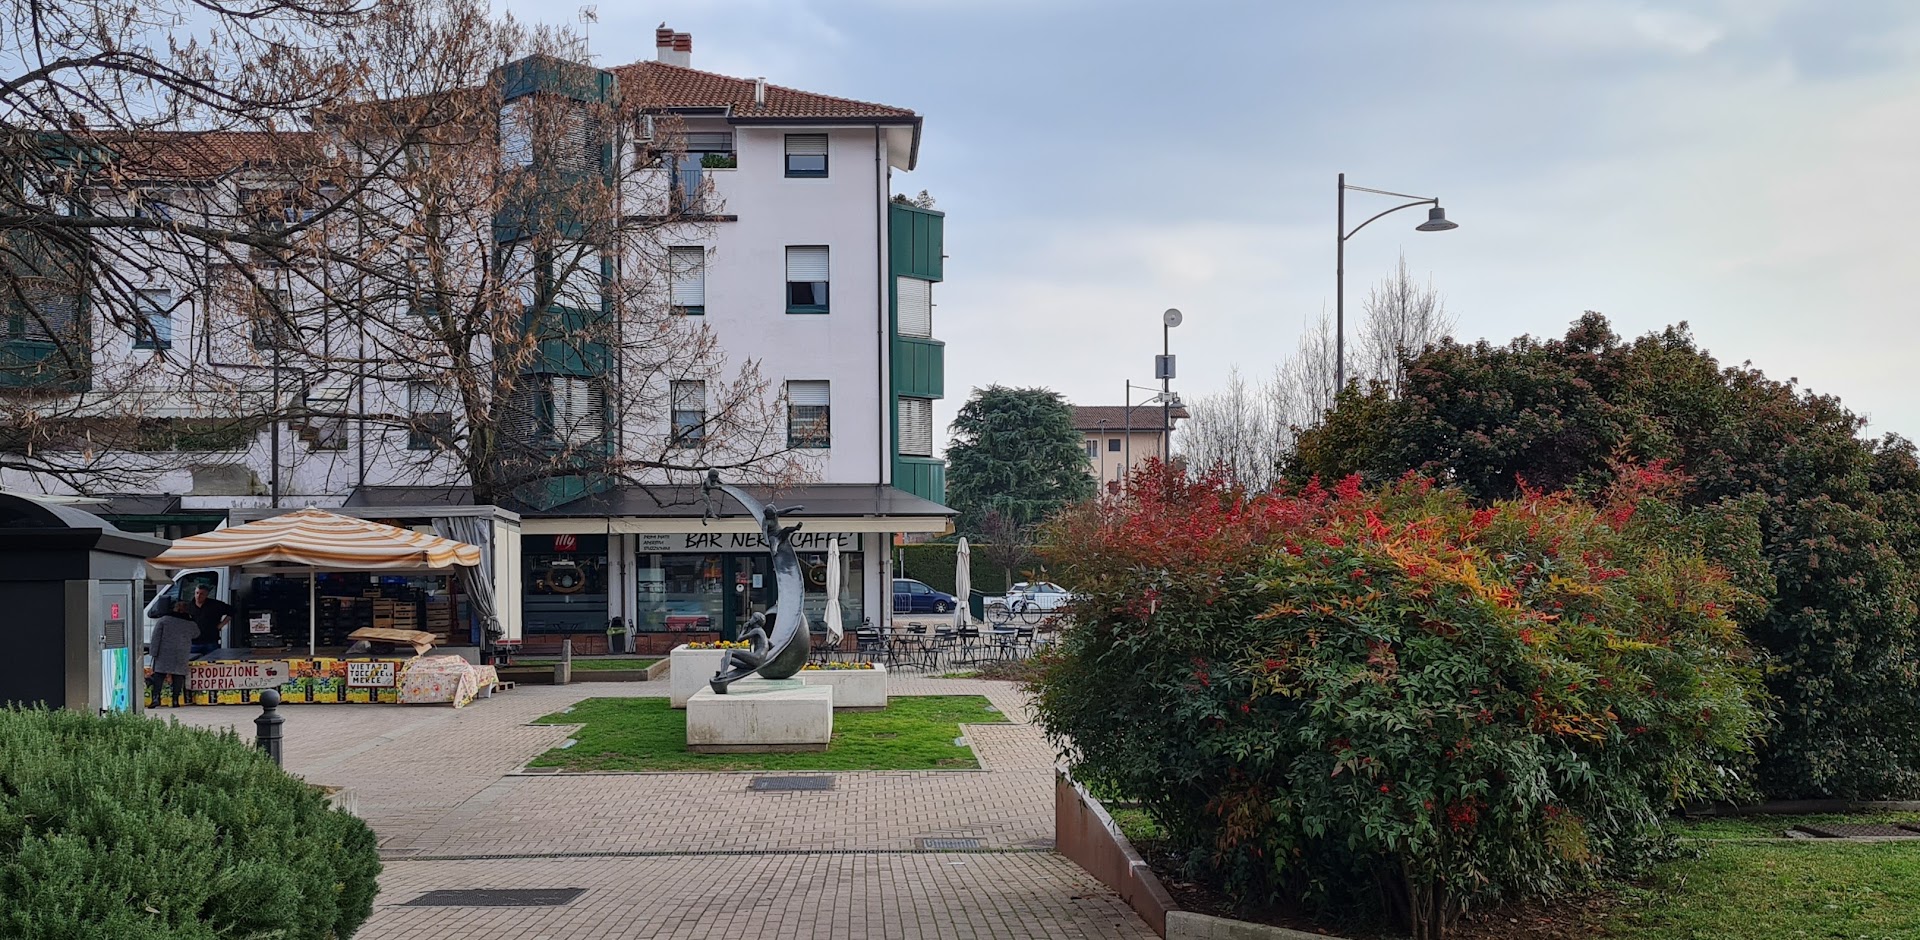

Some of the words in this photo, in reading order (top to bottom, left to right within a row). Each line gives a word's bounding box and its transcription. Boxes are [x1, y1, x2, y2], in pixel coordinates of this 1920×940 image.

[555, 534, 575, 549] illy
[685, 533, 722, 548] BAR
[731, 533, 769, 548] NER
[190, 665, 259, 678] PRODUZIONE
[190, 679, 235, 689] PROPRIA
